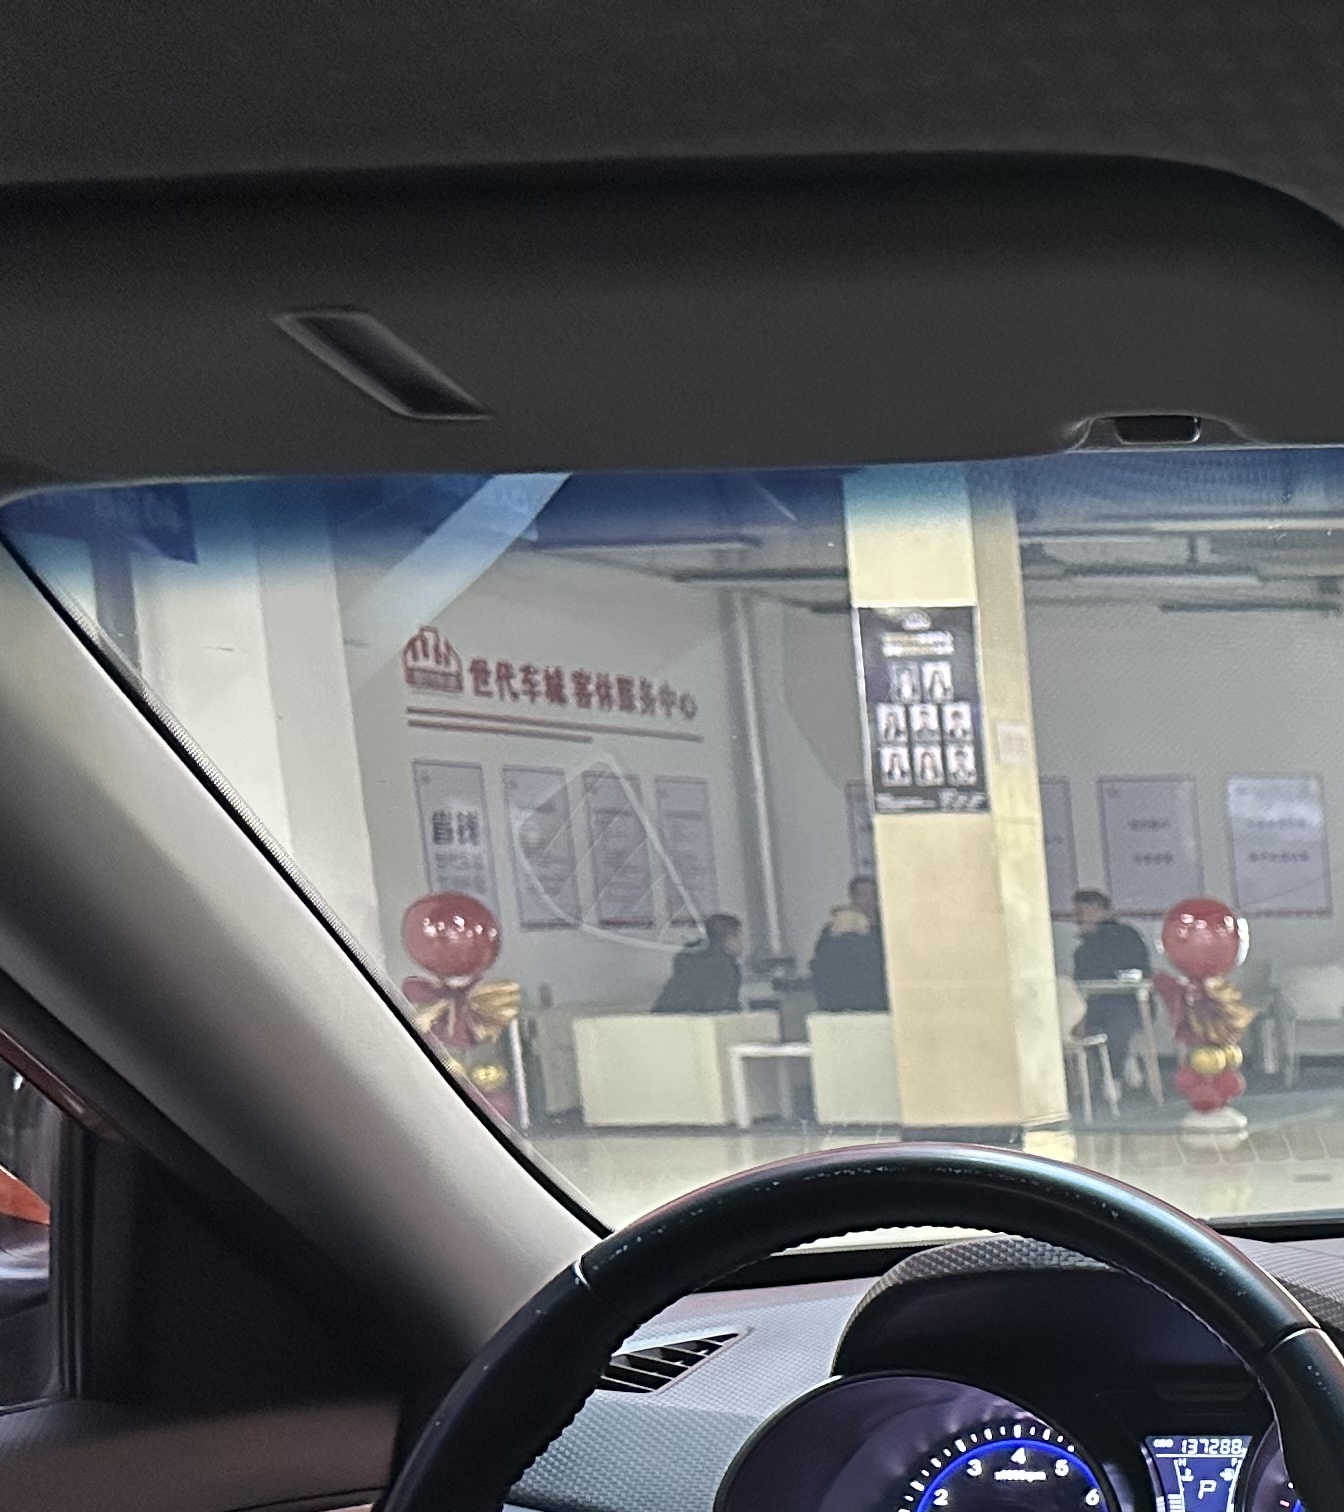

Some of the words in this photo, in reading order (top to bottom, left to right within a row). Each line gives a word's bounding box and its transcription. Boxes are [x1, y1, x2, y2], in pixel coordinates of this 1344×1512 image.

[1010, 1447, 1026, 1464] 4
[1181, 1439, 1243, 1455] 137288
[967, 1459, 982, 1476] 3
[1055, 1460, 1069, 1476] 5
[933, 1488, 949, 1506] 2
[1086, 1489, 1100, 1506] 6
[1198, 1479, 1217, 1499] P
